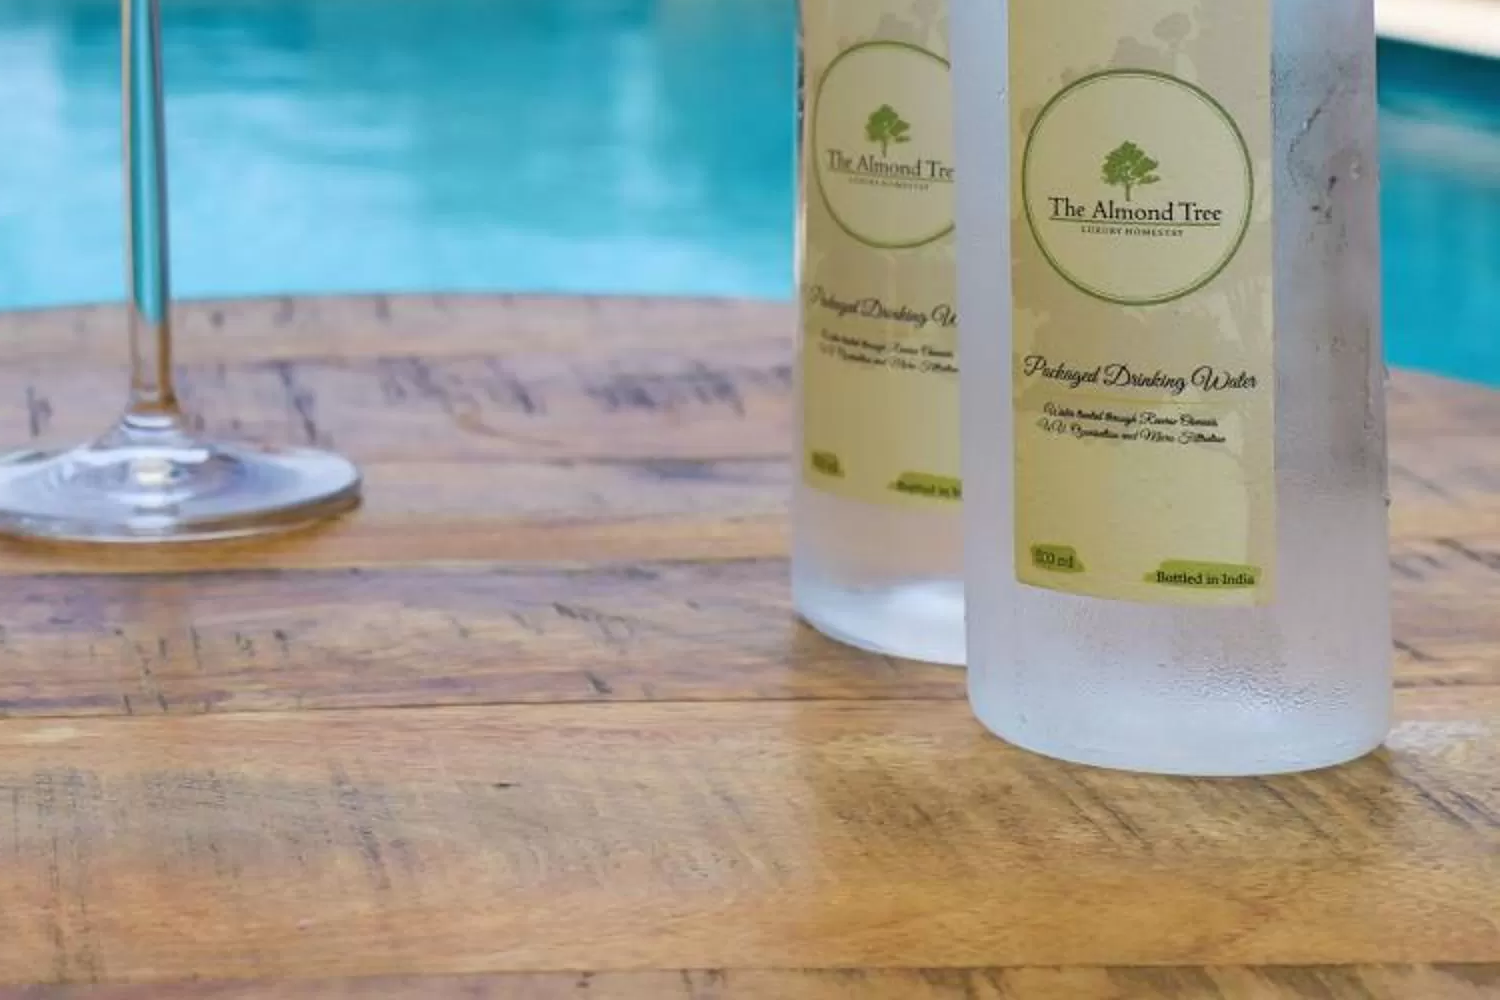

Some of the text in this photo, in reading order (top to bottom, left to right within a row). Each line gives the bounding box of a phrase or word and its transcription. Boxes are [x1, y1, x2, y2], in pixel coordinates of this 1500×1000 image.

[827, 149, 956, 180] The Almond Tre
[1048, 196, 1222, 222] The Almond Tree
[1023, 355, 1257, 396] Packaged Drinking Water
[1156, 571, 1202, 585] Bottled
[1222, 574, 1255, 585] India
